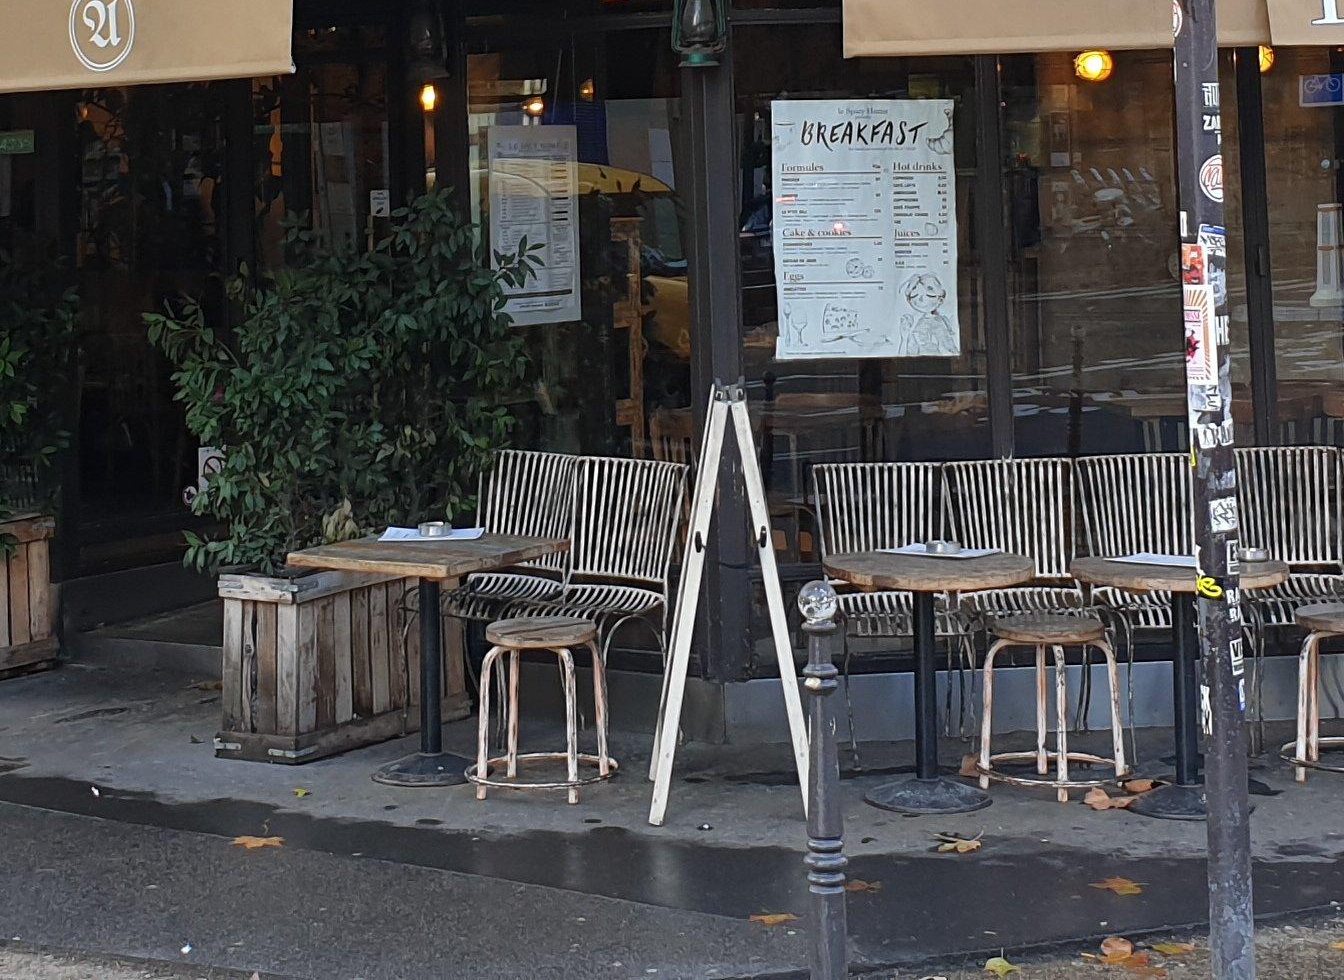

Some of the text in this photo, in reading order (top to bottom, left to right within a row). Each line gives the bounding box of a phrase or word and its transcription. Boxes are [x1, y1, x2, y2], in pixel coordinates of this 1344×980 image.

[799, 119, 930, 152] BREAKFAST
[781, 162, 824, 172] Formules
[893, 161, 943, 171] Hot drinks
[782, 227, 853, 237] Cake & cookies
[893, 228, 921, 238] Juices
[783, 271, 805, 282] Eggs
